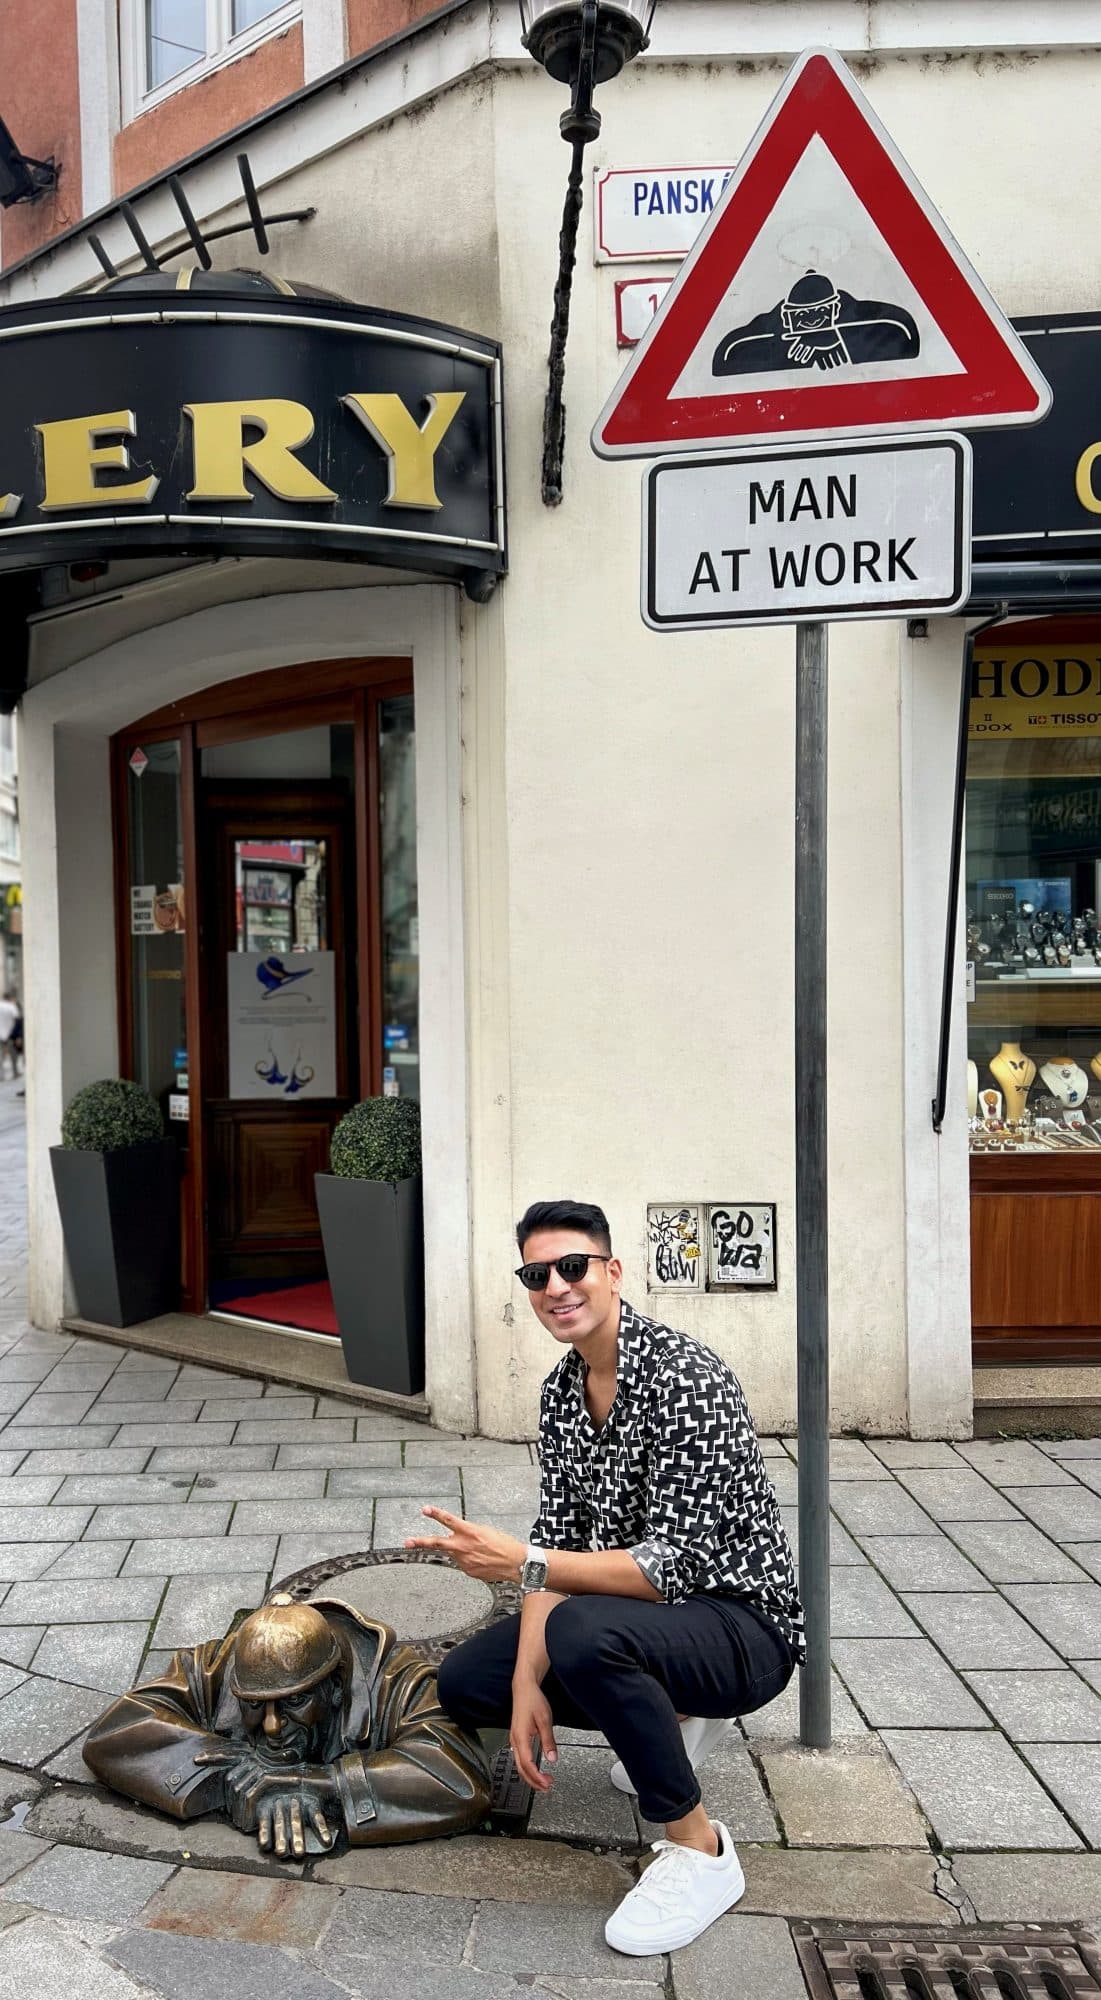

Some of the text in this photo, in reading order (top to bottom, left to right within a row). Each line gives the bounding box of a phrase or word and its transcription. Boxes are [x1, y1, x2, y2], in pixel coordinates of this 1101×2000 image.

[0, 391, 467, 518] ERY
[749, 473, 858, 525] MAN
[688, 537, 919, 595] AT WORK
